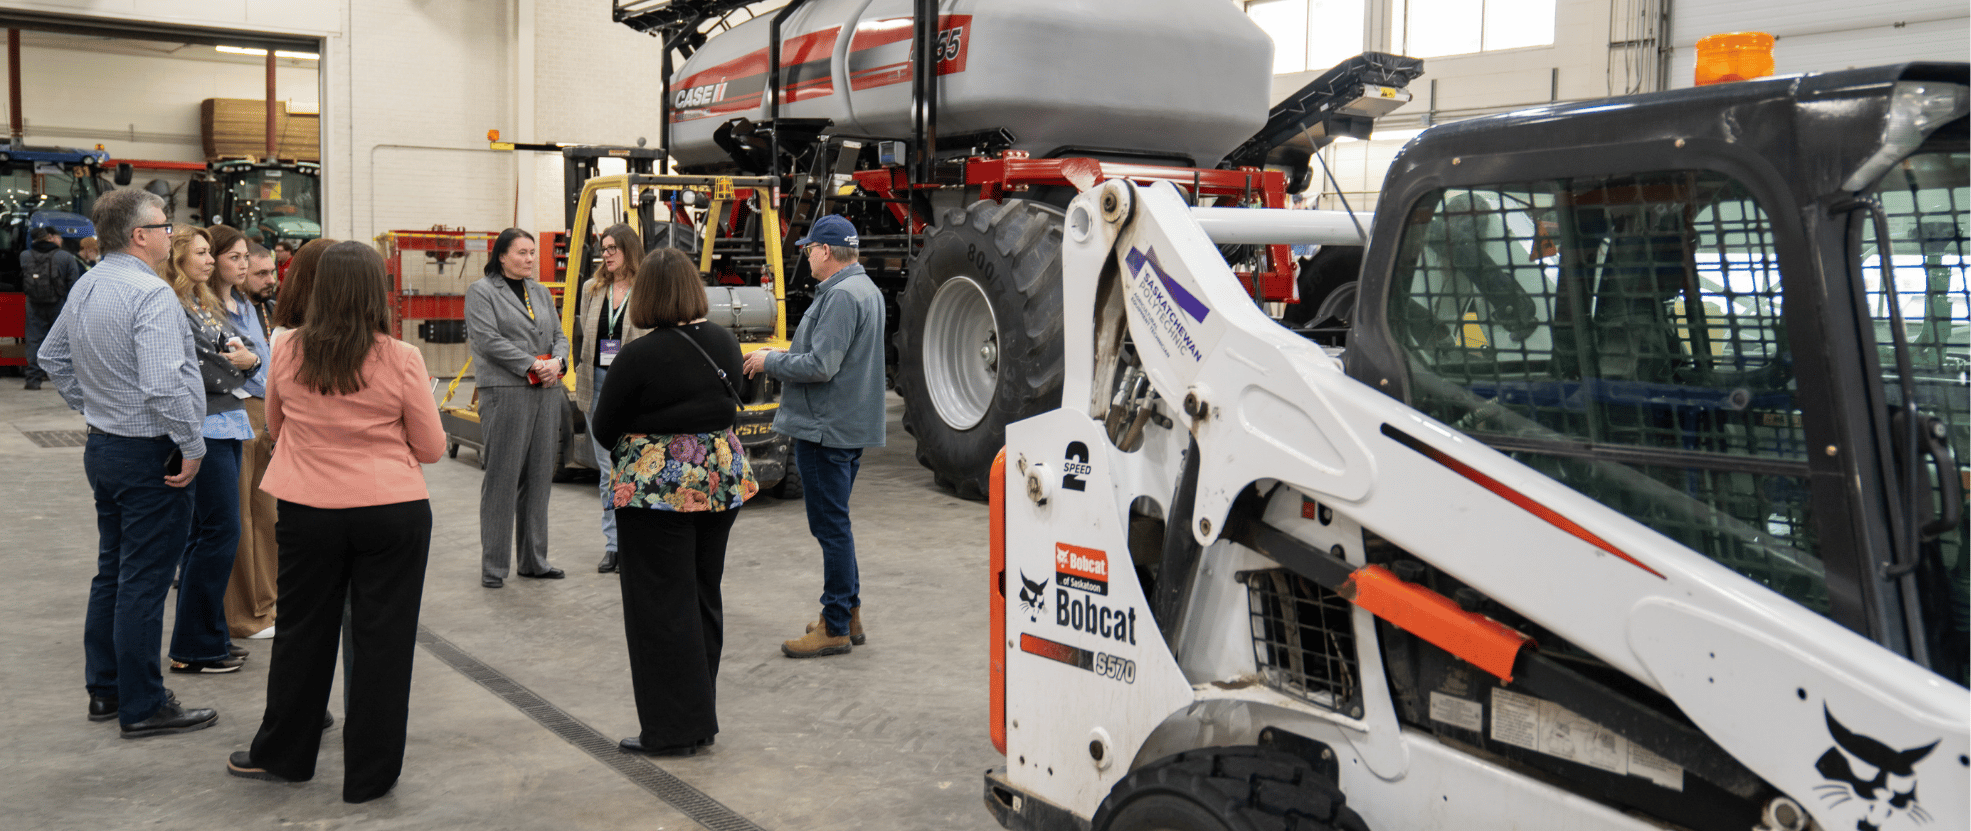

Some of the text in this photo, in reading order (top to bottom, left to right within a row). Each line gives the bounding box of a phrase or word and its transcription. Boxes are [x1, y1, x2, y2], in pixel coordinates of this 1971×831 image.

[675, 84, 714, 109] CASE
[1130, 296, 1171, 358] EQUIPMENT TECHNICIAN
[1133, 292, 1159, 330] AGRICULTURAL
[1138, 281, 1188, 356] POLYTECHNIC
[1143, 272, 1203, 363] SASKATCHEWAN
[1062, 440, 1089, 492] 2
[1063, 462, 1092, 475] SPEED
[1069, 552, 1107, 576] Bobcat
[1062, 577, 1101, 593] of Saskatoon
[1056, 587, 1136, 646] Bobcat
[1096, 651, 1136, 685] S570
